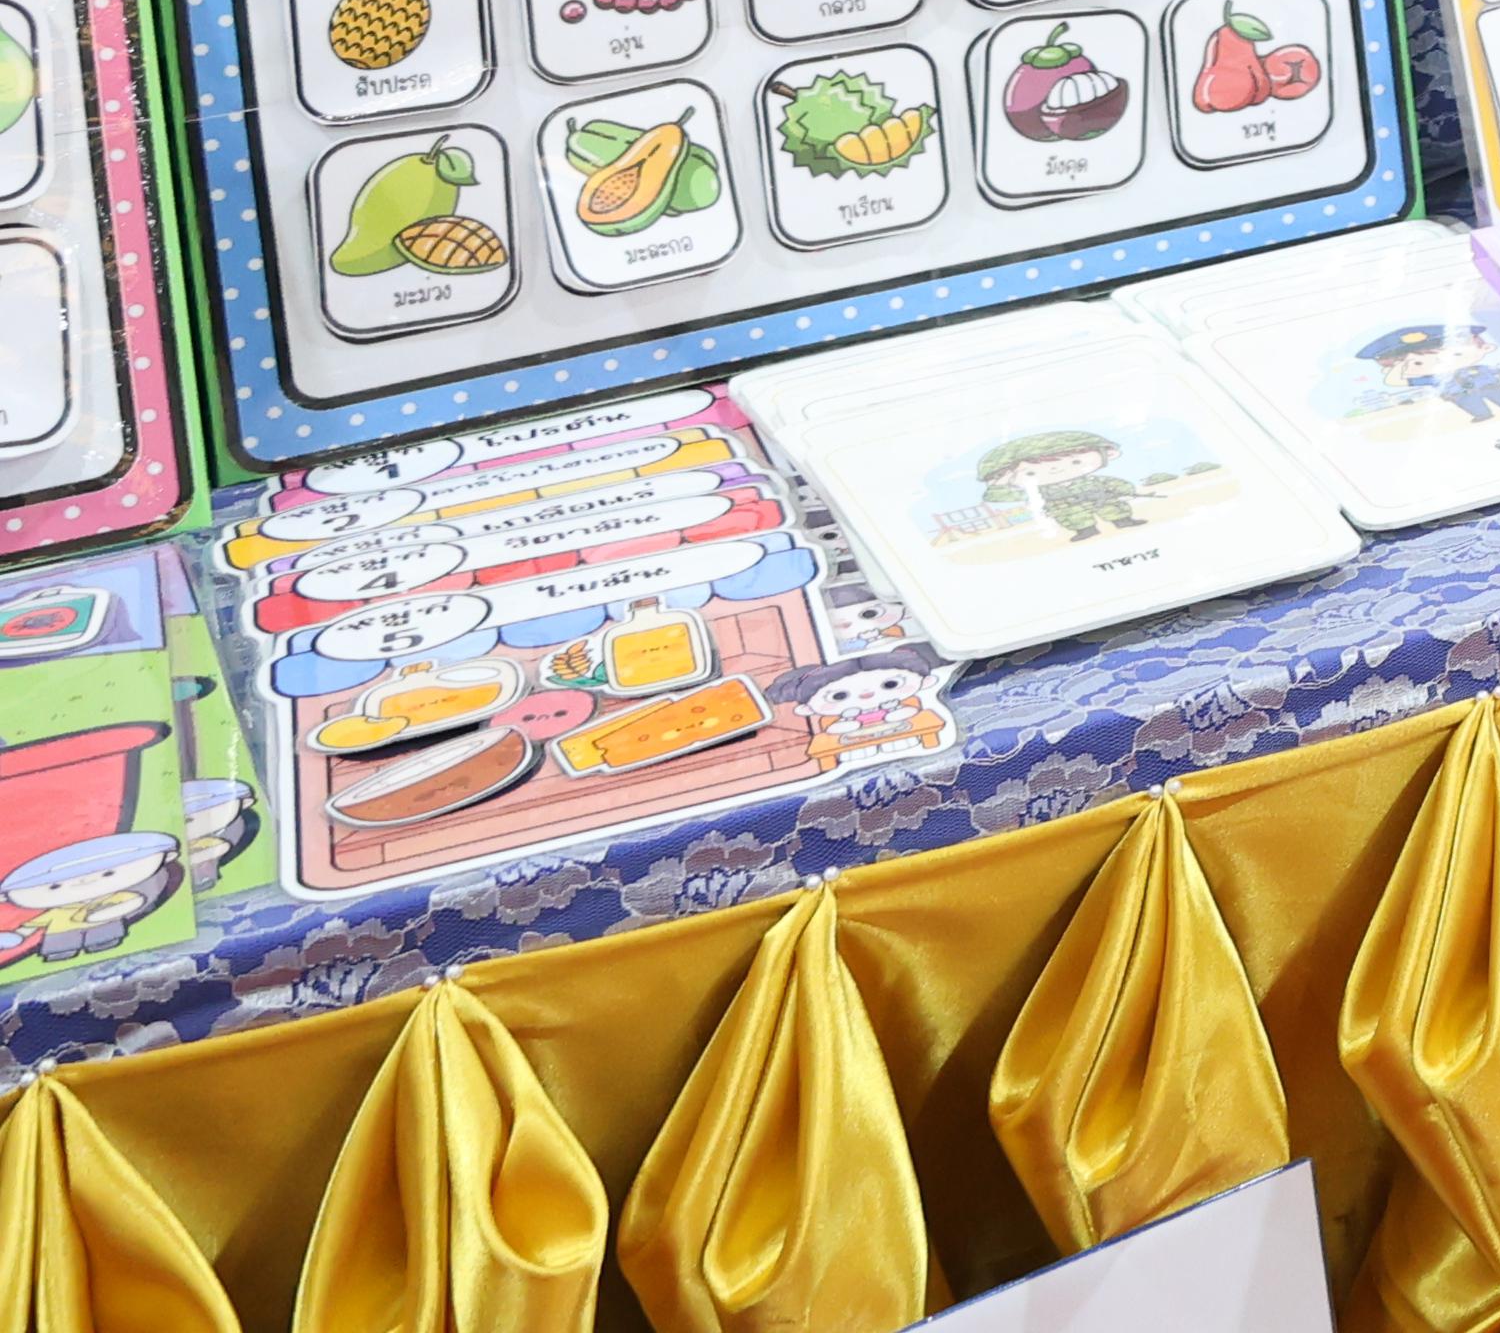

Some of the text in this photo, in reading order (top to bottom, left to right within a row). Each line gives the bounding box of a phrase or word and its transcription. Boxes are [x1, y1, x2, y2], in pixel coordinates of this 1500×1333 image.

[624, 235, 695, 265] มะละกอ
[393, 275, 453, 308] มะม่วง
[321, 514, 362, 534] 2
[356, 570, 406, 593] 4
[379, 627, 424, 654] 5
